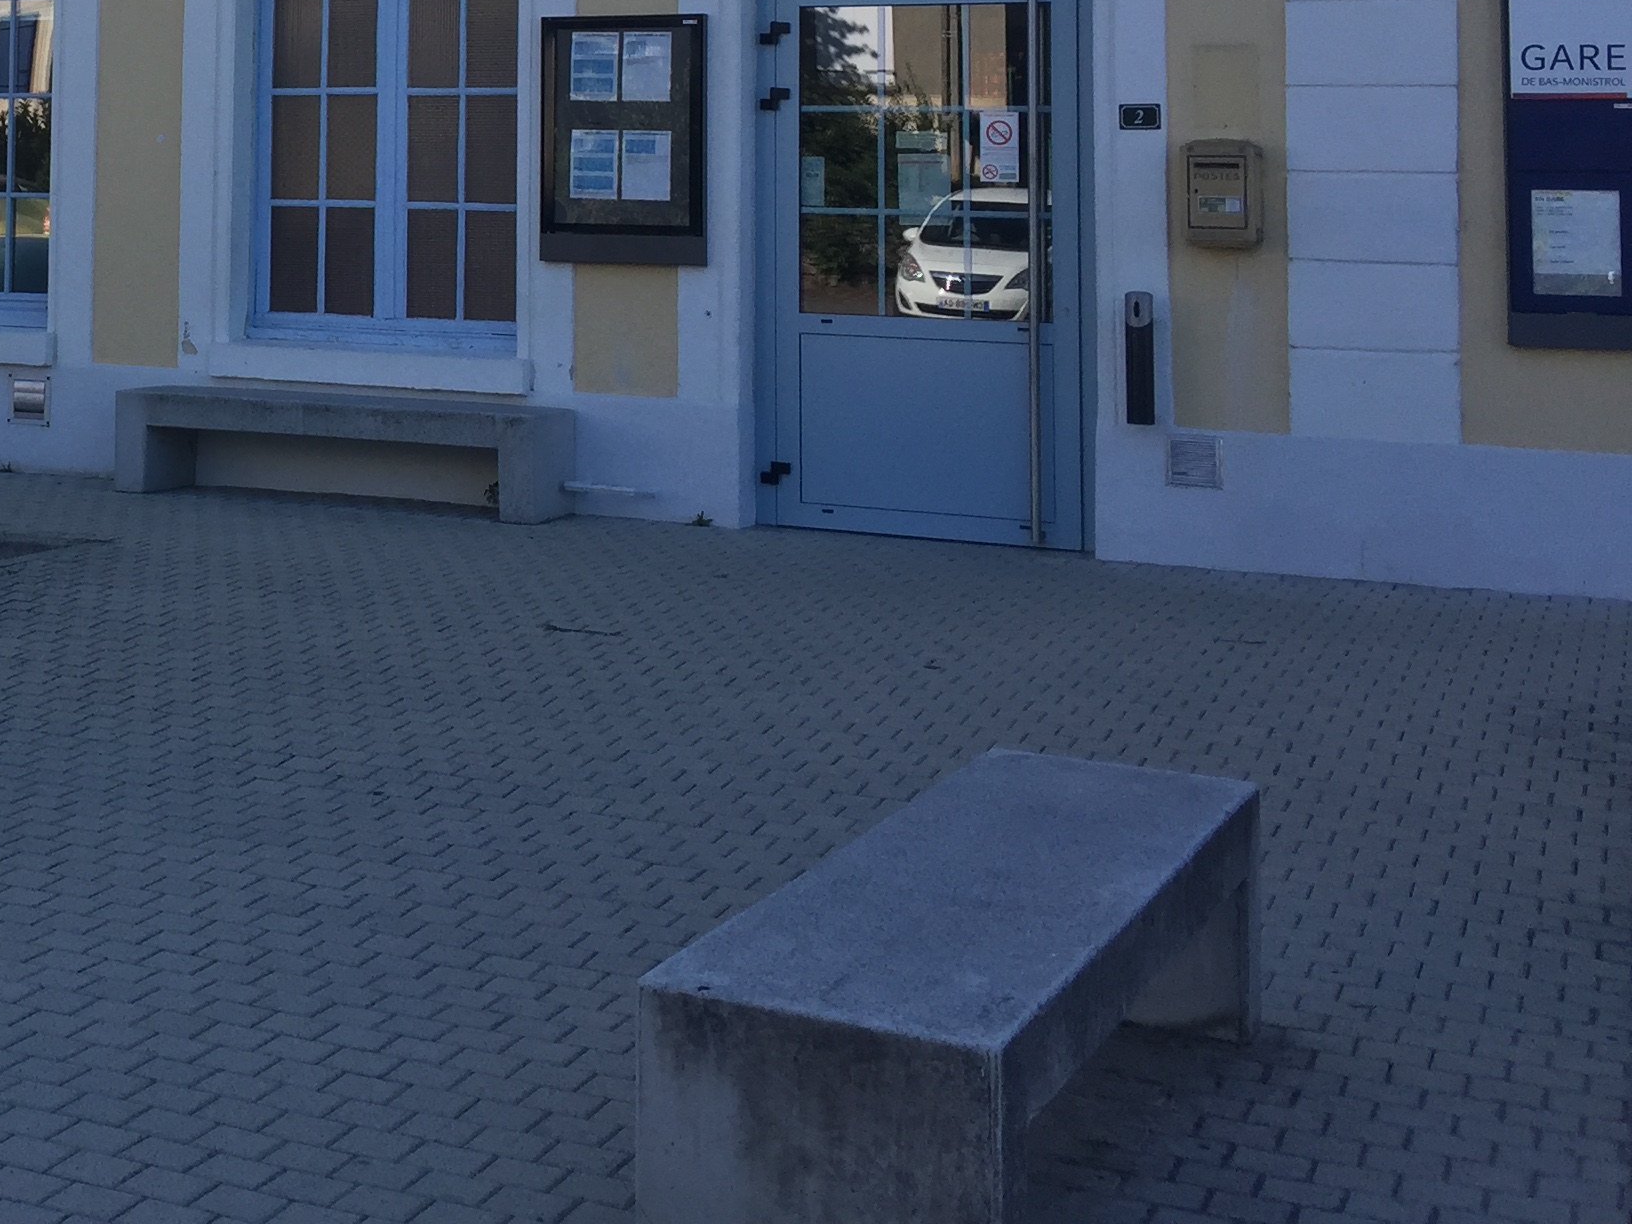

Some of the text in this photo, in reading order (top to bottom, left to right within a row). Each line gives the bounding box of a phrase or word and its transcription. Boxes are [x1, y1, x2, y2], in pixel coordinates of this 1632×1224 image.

[1520, 43, 1627, 71] GARE
[1521, 77, 1626, 87] DE BAS-MONISTROL
[1133, 109, 1144, 124] 2
